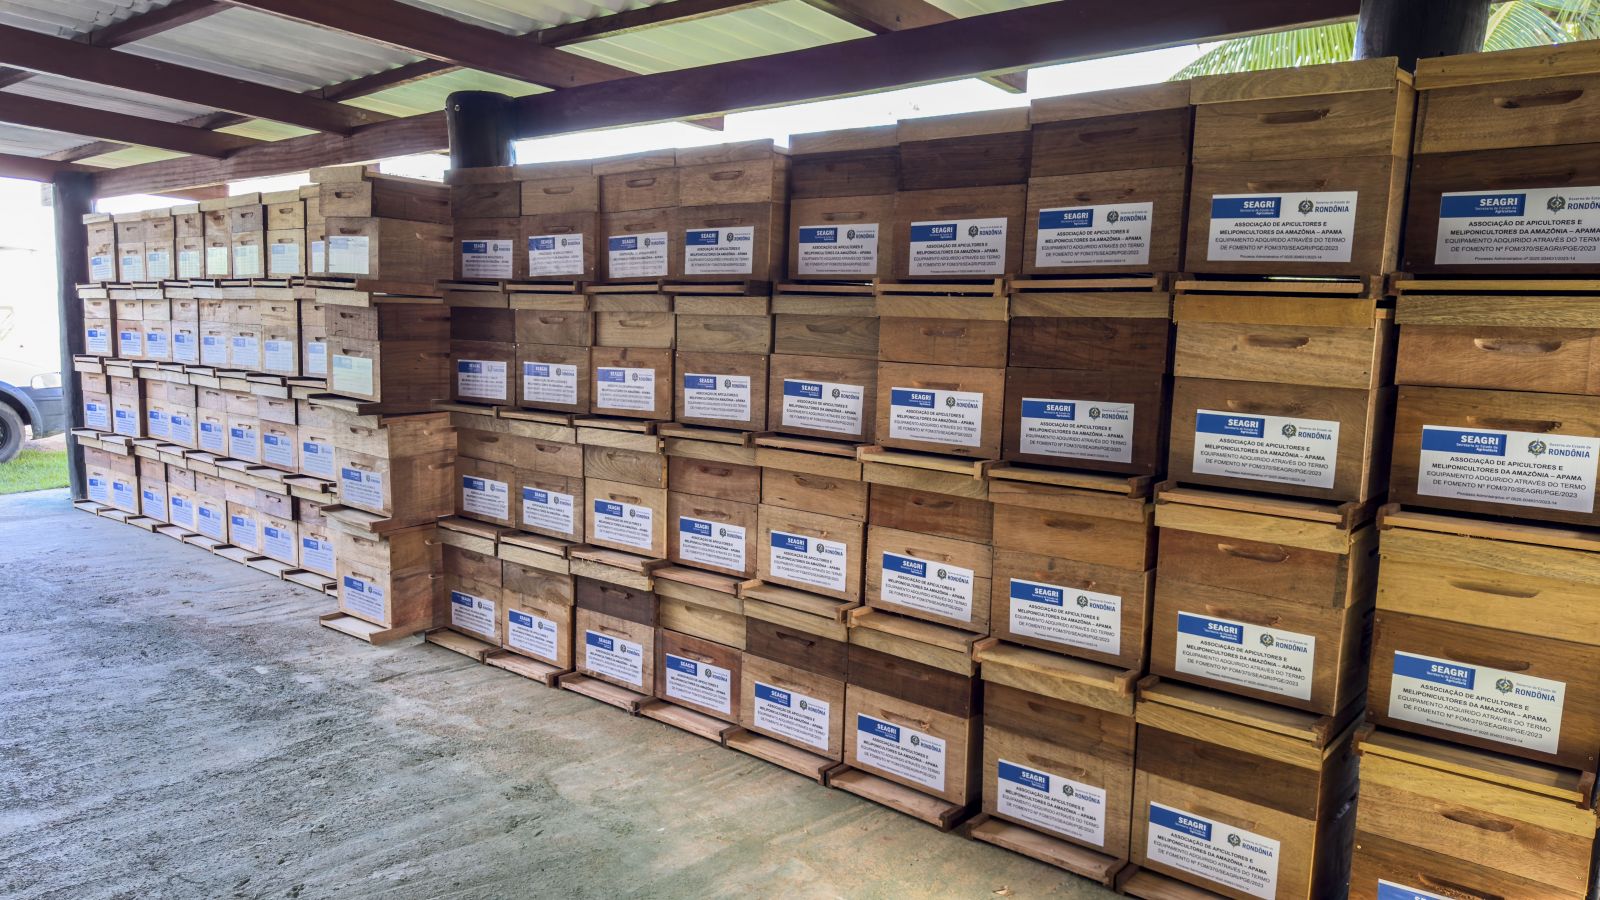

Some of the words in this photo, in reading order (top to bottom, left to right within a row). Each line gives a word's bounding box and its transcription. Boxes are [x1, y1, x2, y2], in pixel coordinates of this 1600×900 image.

[1479, 197, 1517, 206] SEAGRI
[1228, 418, 1258, 428] SEAGRI
[1298, 431, 1331, 440] RONDÔNIA
[1460, 435, 1498, 445] SEAGRI
[1204, 444, 1258, 453] MELIPONICULTORES
[1548, 448, 1590, 457] RONDÔNIA
[1432, 463, 1498, 473] MELIPONICULTORES
[1507, 461, 1556, 470] APICULTORES
[1426, 470, 1474, 479] EQUIPAMENTO
[1475, 474, 1513, 483] ADQUIRIDO
[903, 560, 922, 569] SEAGRI
[947, 575, 968, 584] RONDÔNIA
[1034, 587, 1058, 597] SEAGRI
[1089, 602, 1115, 611] RONDÔNIA
[1208, 622, 1237, 634] SEAGRI
[1200, 640, 1234, 650] ASSOCIAÇÃO
[1244, 649, 1282, 660] APICULTORES
[1275, 642, 1307, 653] RONDÔNIA
[1186, 644, 1238, 658] MELIPONICULTORES
[1248, 657, 1276, 666] AMAZÔNIA
[1431, 664, 1467, 678] SEAGRI
[771, 690, 787, 700] SEAGRI
[1420, 683, 1463, 696] ASSOCIAÇÃO
[1475, 695, 1522, 709] APICULTORES
[1515, 688, 1555, 701] RONDÔNIA
[1402, 688, 1467, 706] MELIPONICULTORES
[1479, 704, 1515, 716] AMAZÔNIA
[1522, 713, 1547, 723] APAMA
[1413, 705, 1445, 716] FOMENTO
[1397, 694, 1443, 708] EQUIPAMENTO
[1444, 704, 1481, 717] ADQUIRIDO
[1482, 712, 1512, 723] ATRAVÉS
[1525, 722, 1551, 732] TERMO
[877, 723, 896, 734] SEAGRI
[920, 742, 941, 752] RONDÔNIA
[1022, 771, 1044, 783] SEAGRI
[1075, 792, 1100, 804] RONDÔNIA
[1178, 816, 1206, 831] SEAGRI
[1170, 832, 1203, 846] ASSOCIAÇÃO
[1212, 846, 1248, 861] APICULTORES
[1242, 843, 1272, 857] RONDÔNIA
[1157, 834, 1206, 854] MELIPONICULTORES
[1215, 854, 1243, 866] AMAZÔNIA
[1248, 865, 1266, 874] APAMA
